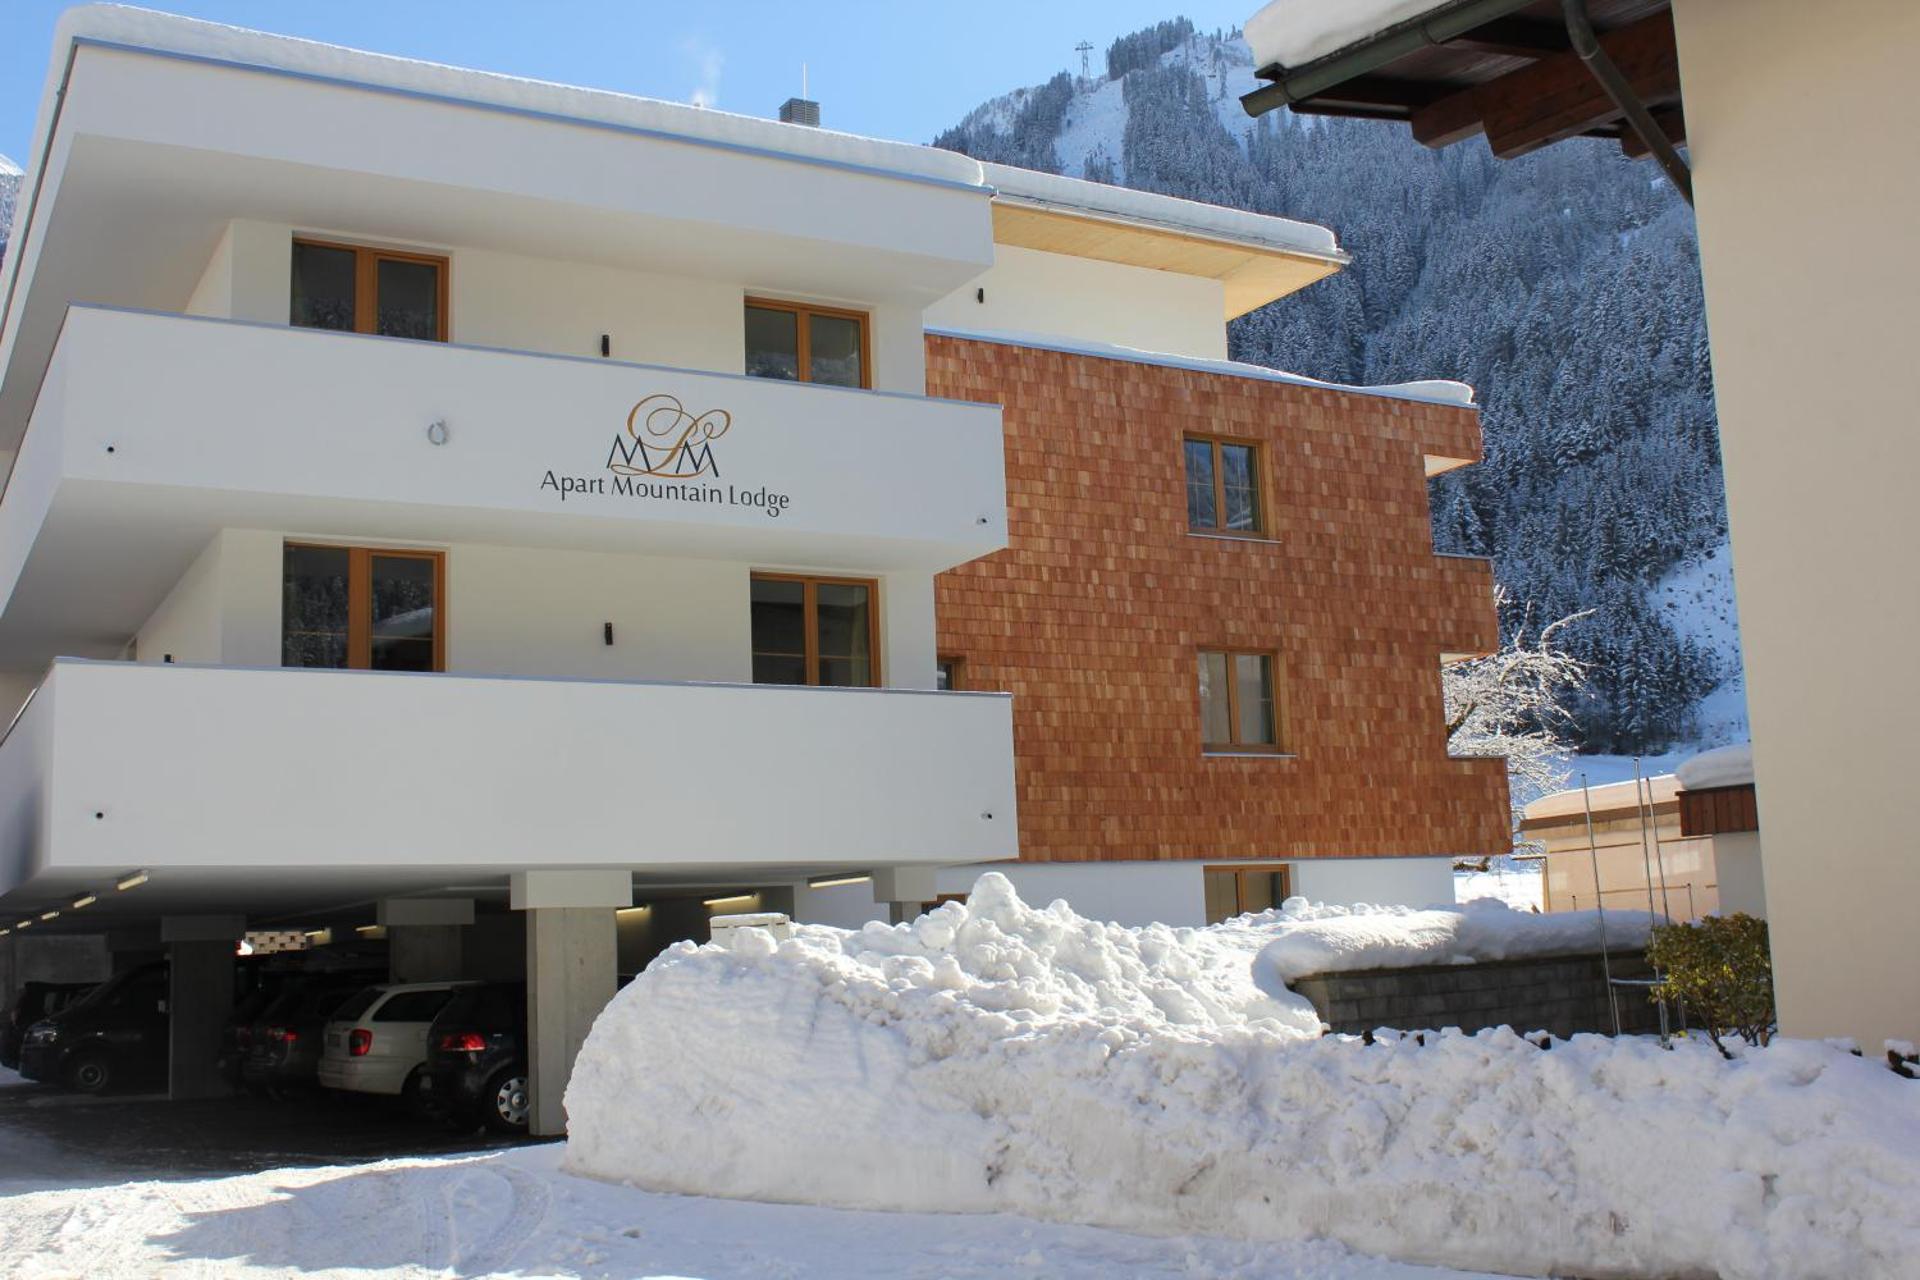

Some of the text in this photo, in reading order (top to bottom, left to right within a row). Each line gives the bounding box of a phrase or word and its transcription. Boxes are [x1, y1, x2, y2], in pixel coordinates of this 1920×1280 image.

[541, 470, 790, 517] Apart Mountain Lodge
